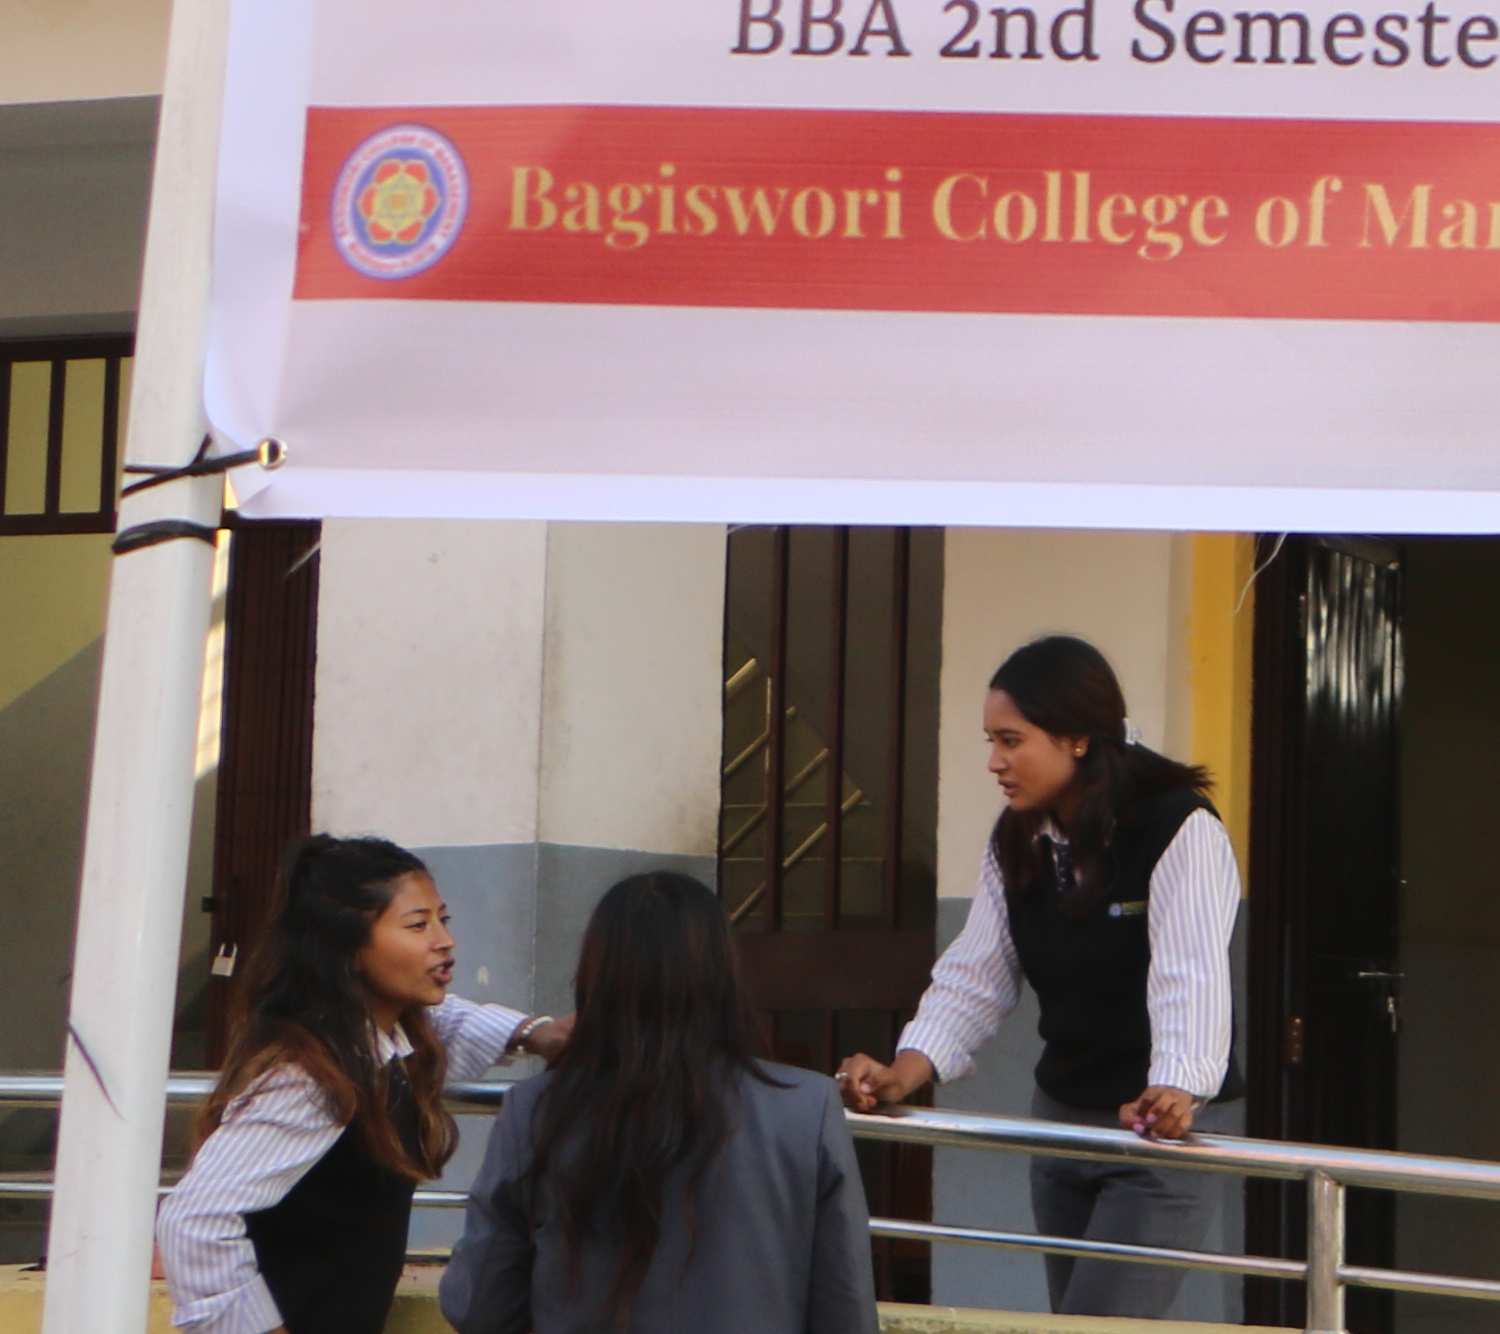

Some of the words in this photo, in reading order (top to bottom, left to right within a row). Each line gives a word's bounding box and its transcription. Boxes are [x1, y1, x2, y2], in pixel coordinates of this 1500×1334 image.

[507, 162, 904, 247] Bagiswori
[932, 170, 1230, 261] College
[1254, 175, 1341, 249] of
